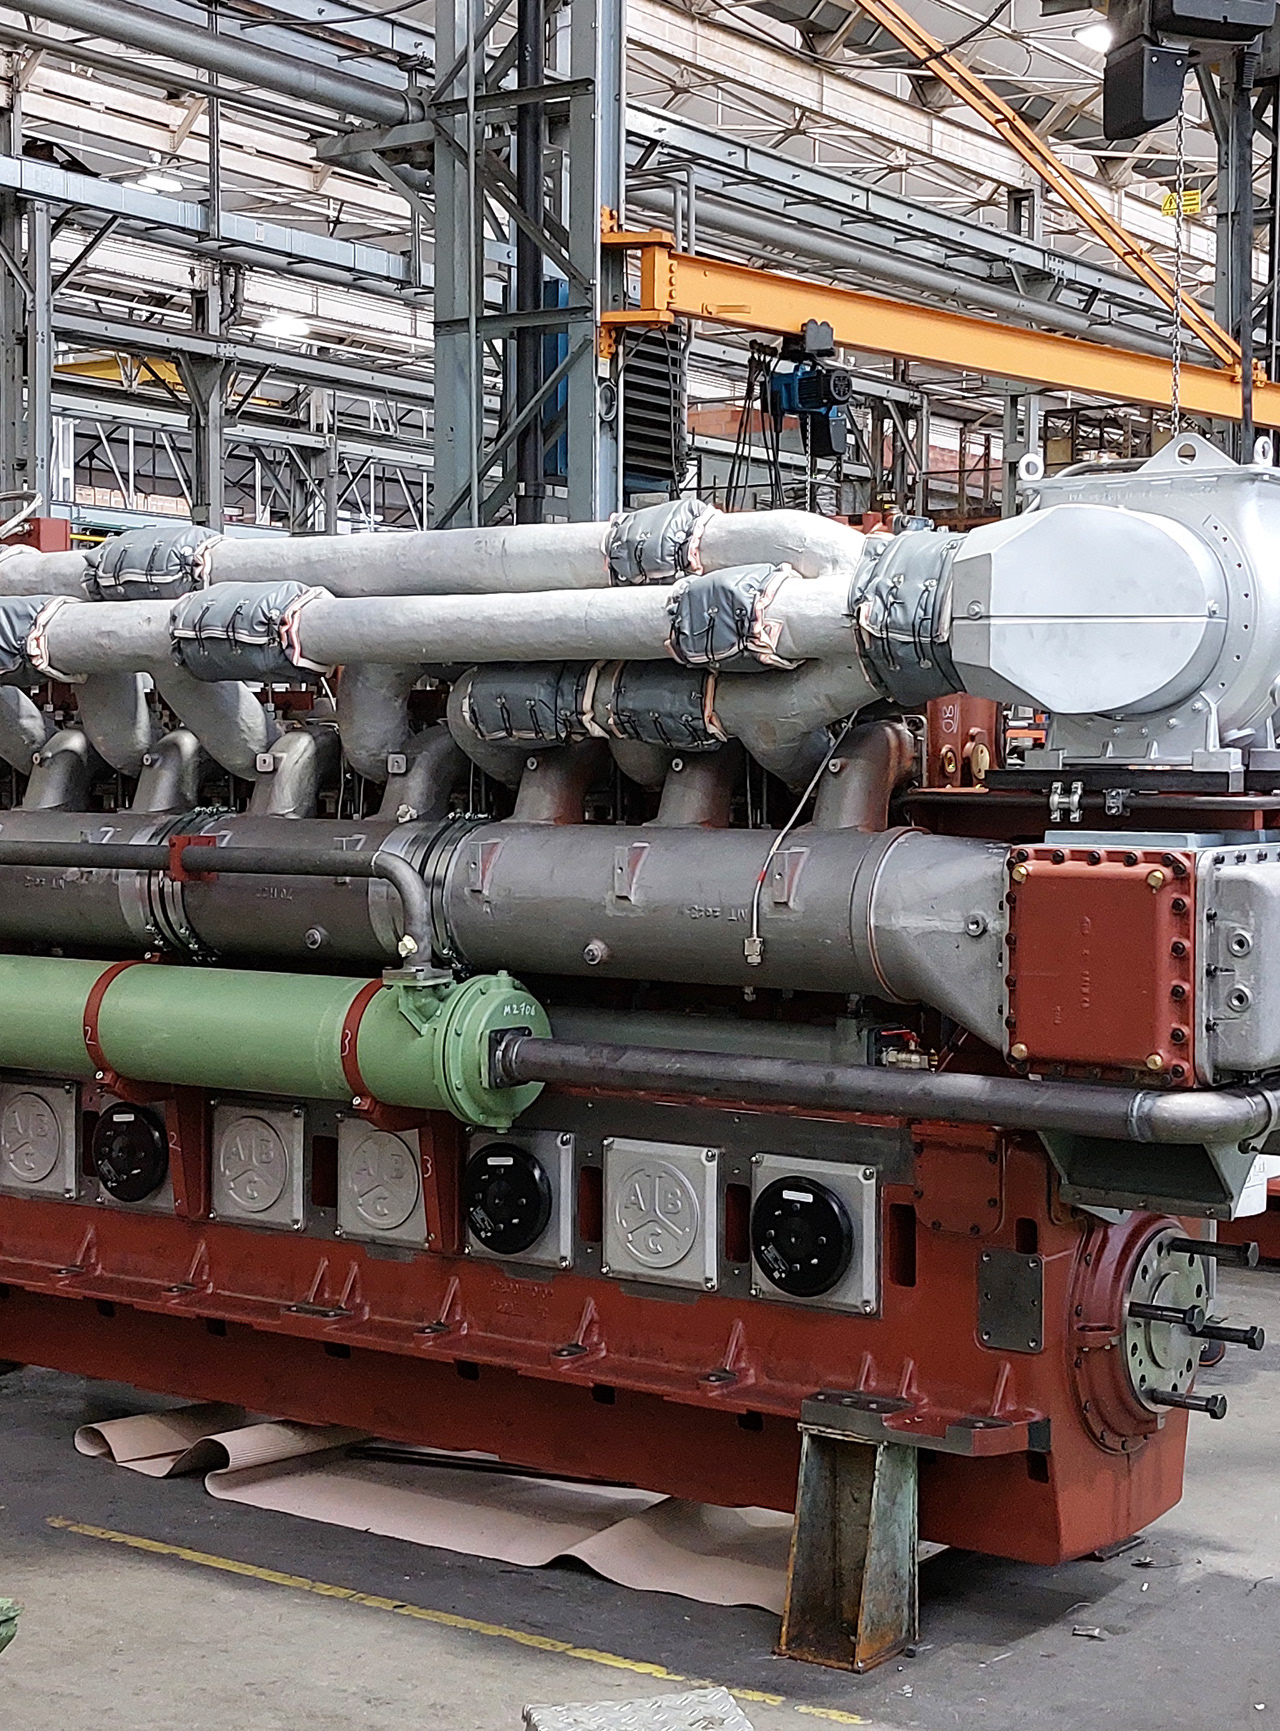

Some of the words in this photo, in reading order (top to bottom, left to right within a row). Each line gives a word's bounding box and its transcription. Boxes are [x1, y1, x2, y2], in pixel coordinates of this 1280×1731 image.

[84, 1026, 97, 1045] 2
[341, 1029, 352, 1056] 3
[422, 1155, 433, 1178] 3
